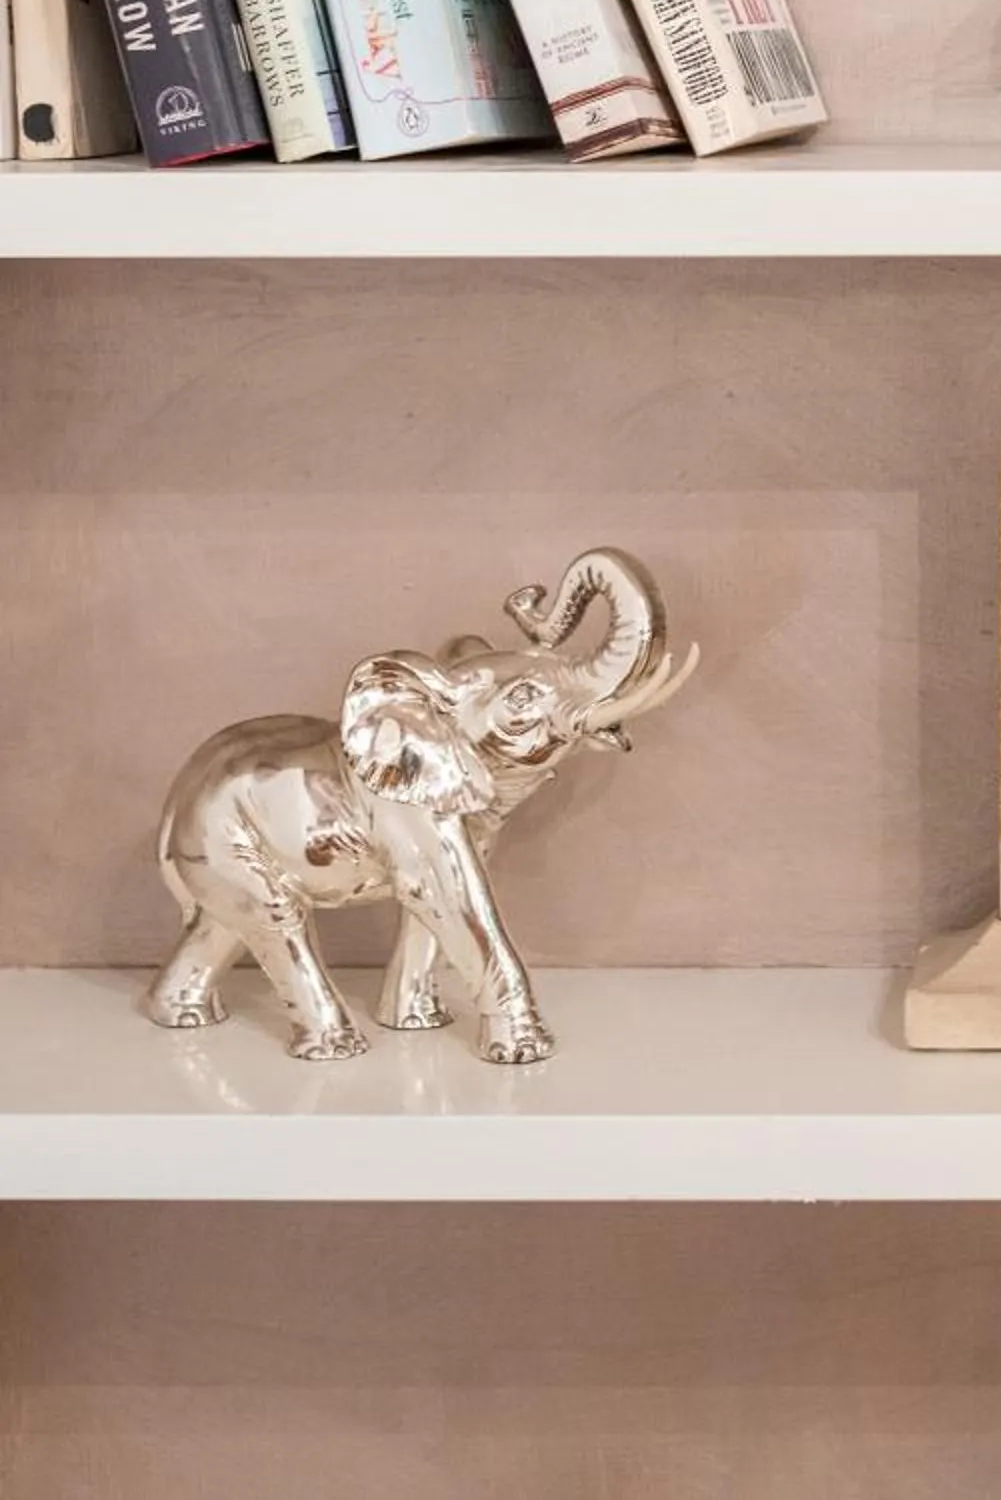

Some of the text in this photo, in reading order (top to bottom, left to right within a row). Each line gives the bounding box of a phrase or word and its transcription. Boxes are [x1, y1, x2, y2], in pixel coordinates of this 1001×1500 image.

[362, 11, 403, 80] sky
[664, 16, 729, 105] SANDFORD
[159, 119, 207, 136] VIKING
